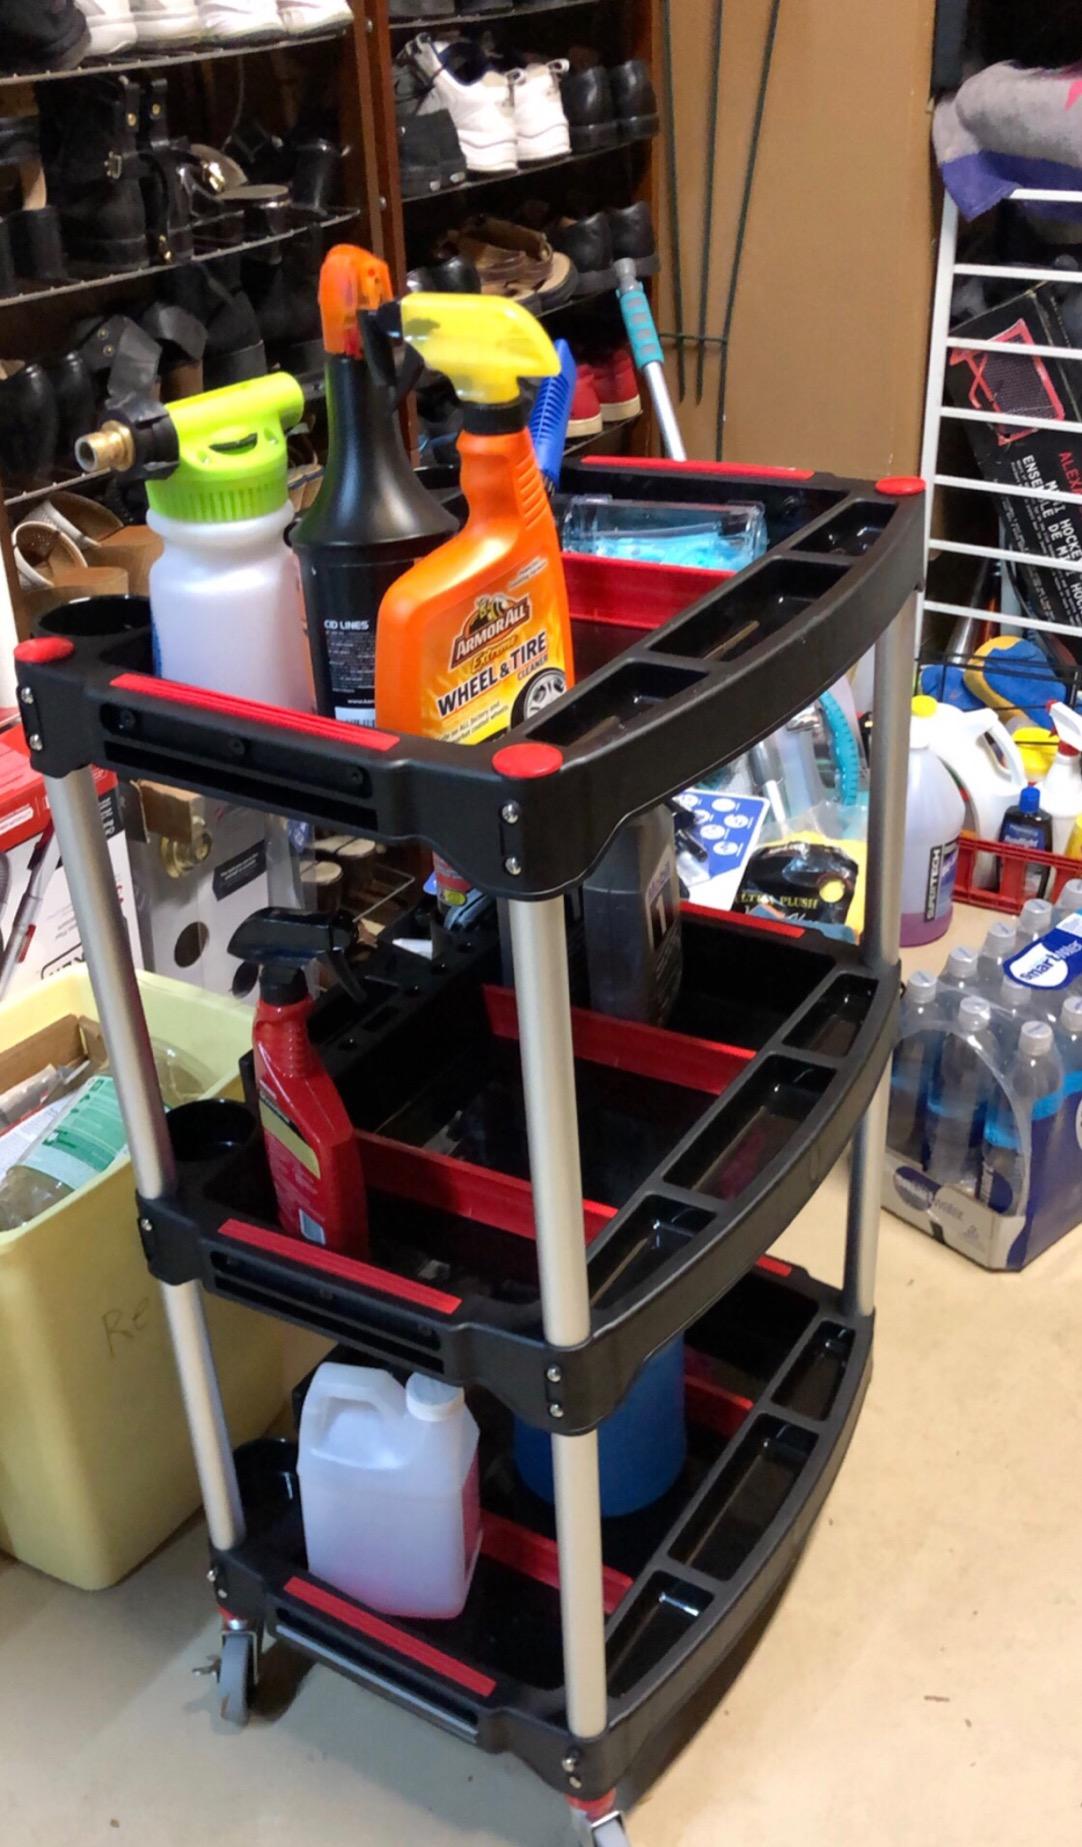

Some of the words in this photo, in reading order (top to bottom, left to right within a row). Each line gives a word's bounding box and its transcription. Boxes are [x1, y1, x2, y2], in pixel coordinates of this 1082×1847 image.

[1059, 451, 1082, 495] ALEX
[1022, 454, 1054, 519] ENSELE
[1047, 522, 1063, 542] DE
[1056, 545, 1073, 577] MII
[1046, 480, 1066, 517] MI
[456, 618, 505, 660] ARMOR
[504, 604, 526, 629] ALL
[438, 667, 498, 716] WHEEL
[499, 662, 510, 678] &
[510, 631, 546, 669] TIRE
[517, 654, 548, 680] CLEANER
[780, 895, 819, 909] PLUSH
